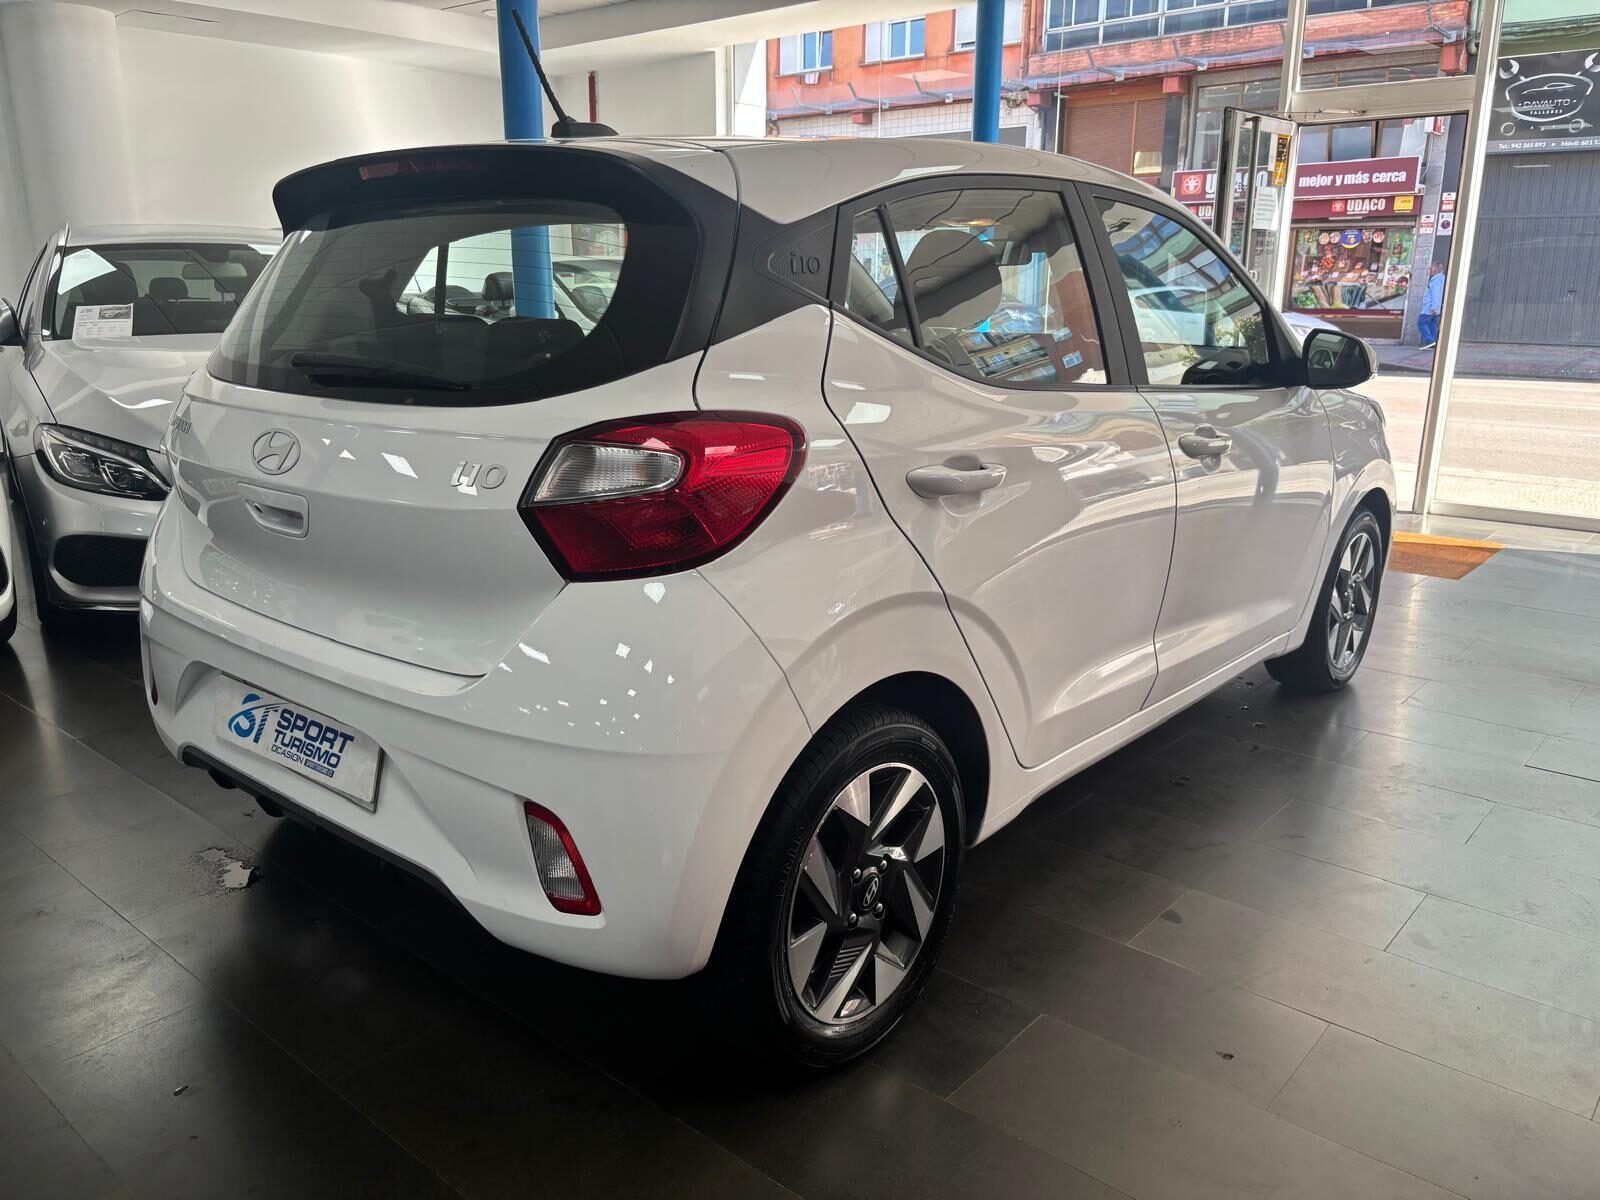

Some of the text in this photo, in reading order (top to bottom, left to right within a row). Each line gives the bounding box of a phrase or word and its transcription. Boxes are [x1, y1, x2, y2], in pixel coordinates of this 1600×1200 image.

[1298, 171, 1407, 188] mejor y más cerca
[1346, 198, 1386, 212] UDACO
[791, 251, 820, 274] i10
[450, 460, 508, 490] i10
[277, 708, 355, 754] SPORT
[271, 744, 305, 764] OCASION
[275, 729, 341, 769] TURISMO
